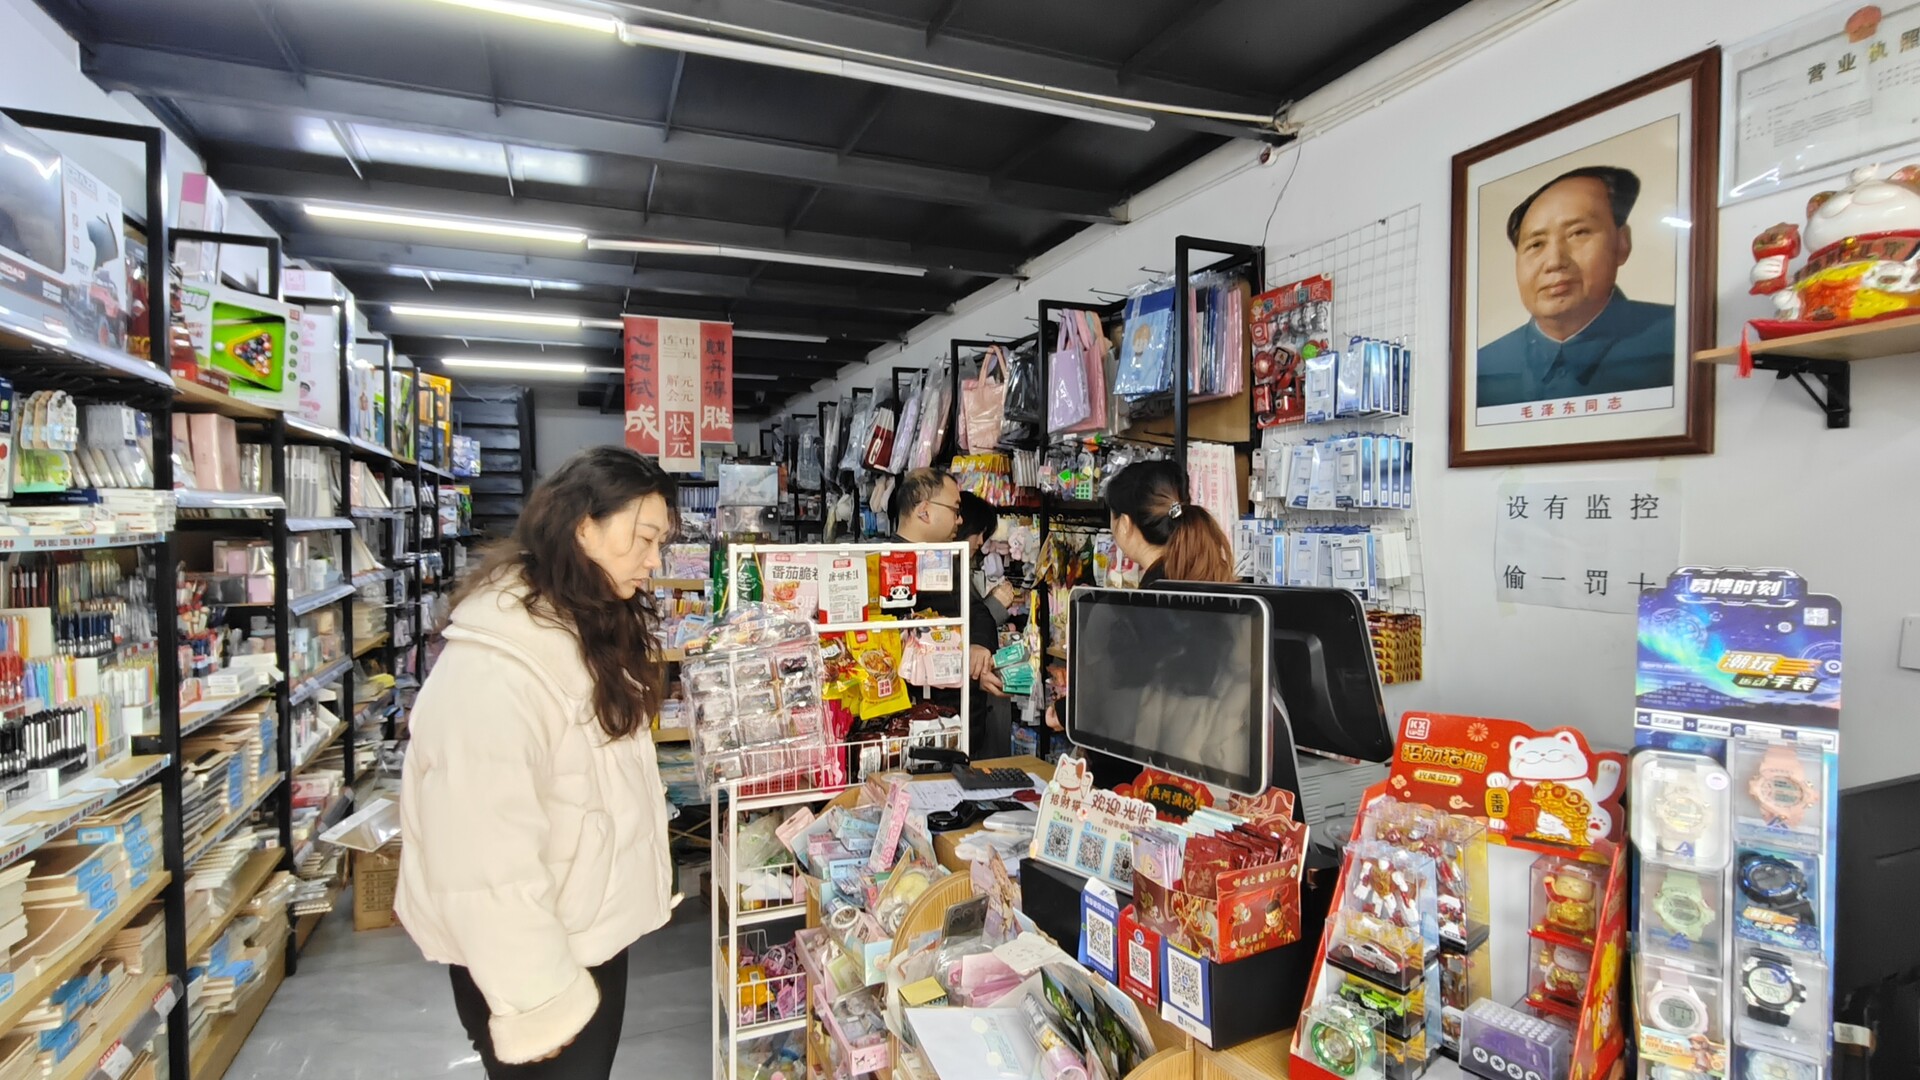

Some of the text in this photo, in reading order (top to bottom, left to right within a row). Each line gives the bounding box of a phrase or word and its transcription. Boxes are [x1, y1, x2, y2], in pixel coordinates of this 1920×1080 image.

[1520, 396, 1623, 419] 毛泽东同志
[667, 413, 692, 457] 状元
[1506, 492, 1660, 521] 设有监控
[1503, 564, 1657, 596] 偷一罚十
[1722, 653, 1777, 672] 潮玩
[1738, 674, 1819, 692] 运动手表
[1402, 743, 1487, 773] 招财猫咪
[1090, 792, 1155, 825] 欢迎光临
